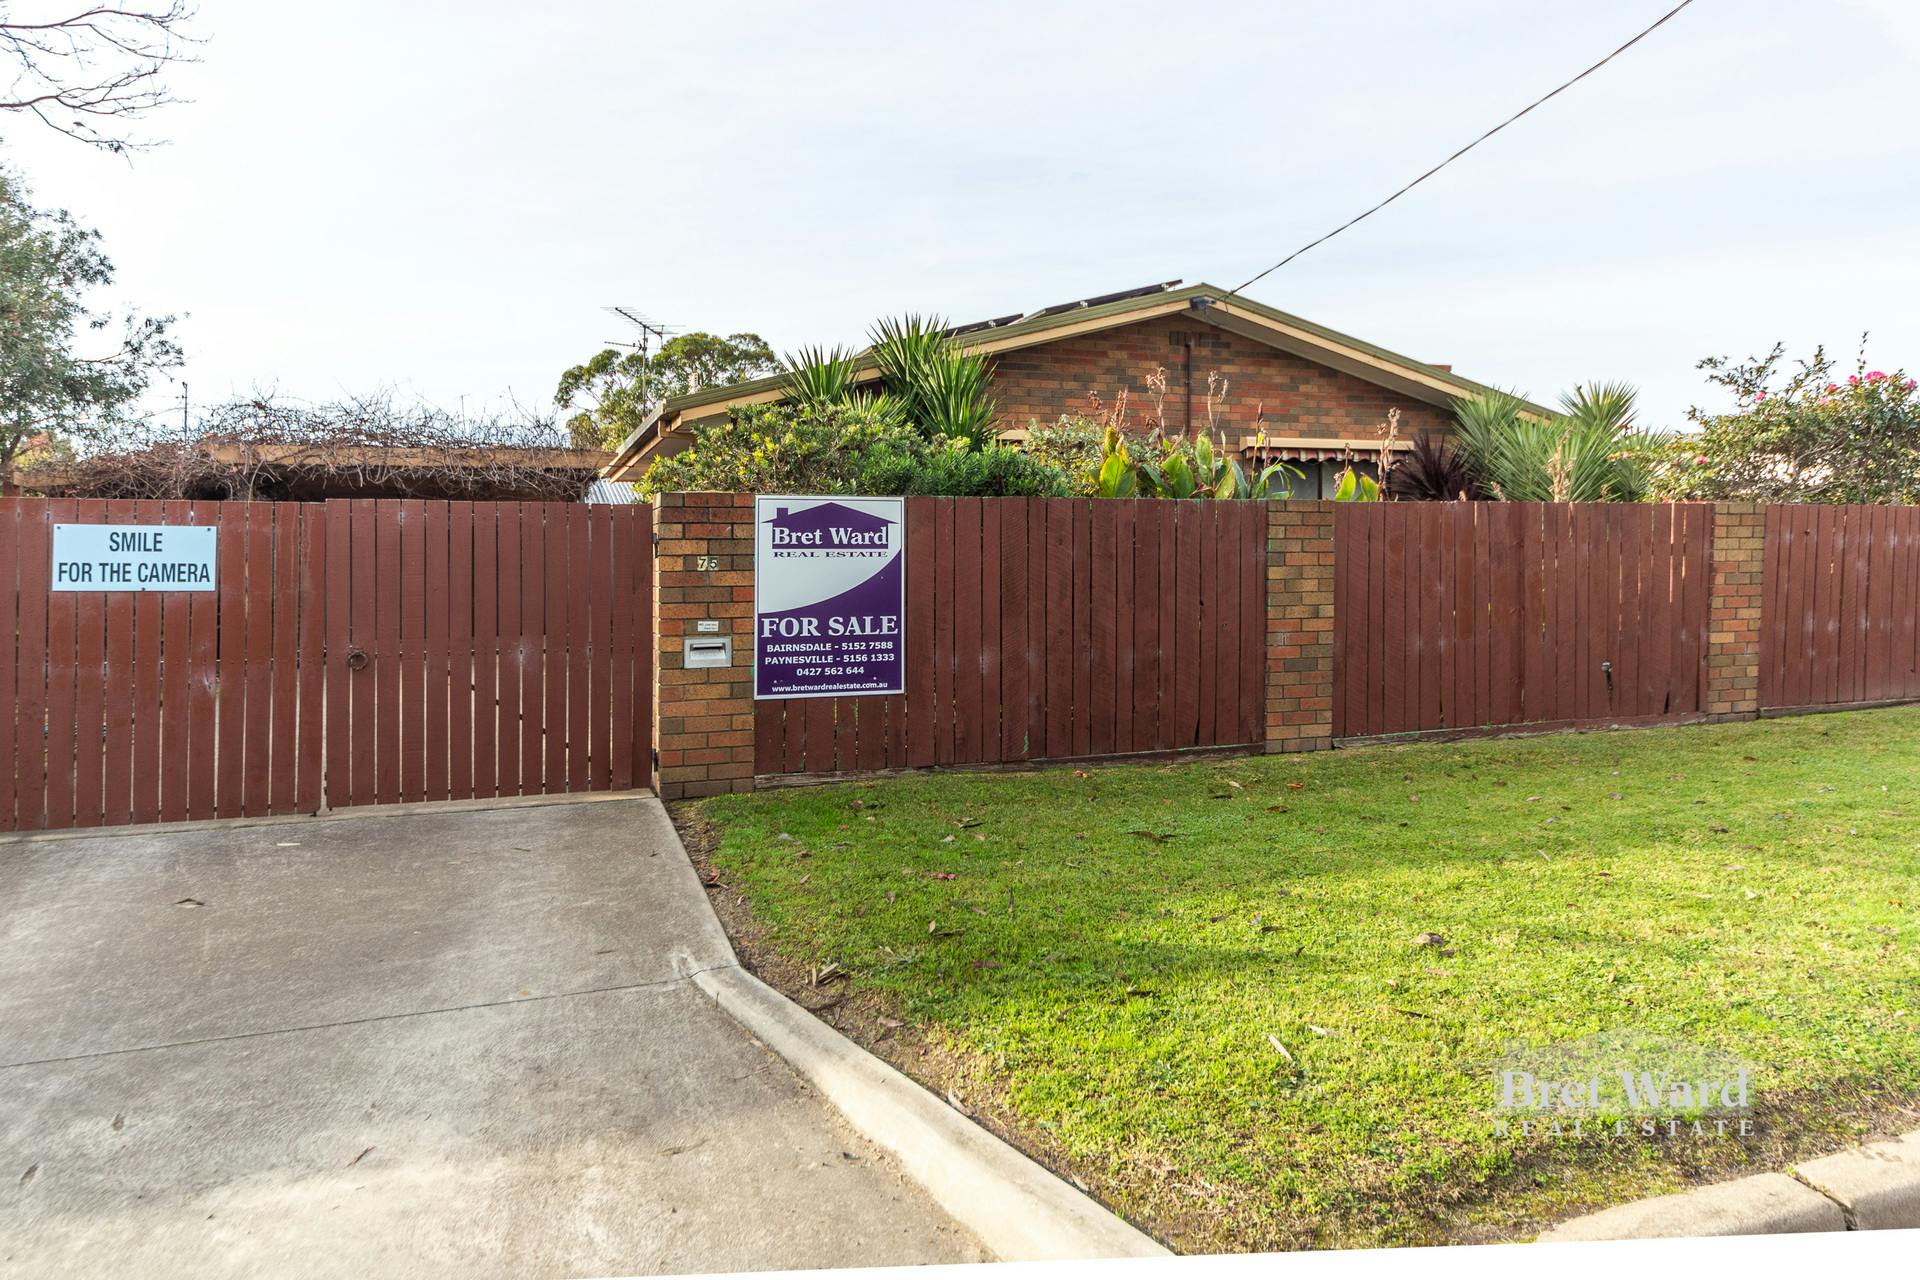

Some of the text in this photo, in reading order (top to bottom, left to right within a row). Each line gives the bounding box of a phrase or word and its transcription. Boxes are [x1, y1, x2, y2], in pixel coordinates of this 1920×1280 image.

[109, 532, 163, 552] SMILE
[773, 526, 888, 545] Bret Ward
[58, 562, 210, 582] FOR THE CAMERA
[761, 615, 898, 638] FOR SALE
[767, 643, 832, 652] BAIRNSDALE
[841, 642, 866, 650] 5152
[869, 641, 893, 649] 7588
[765, 655, 833, 665] PAYNESVILLE
[843, 654, 868, 662] 5156
[871, 653, 895, 661] 1333
[796, 666, 864, 676] 0427 562 644
[772, 682, 888, 692] www.bretwardrealestate.com.au
